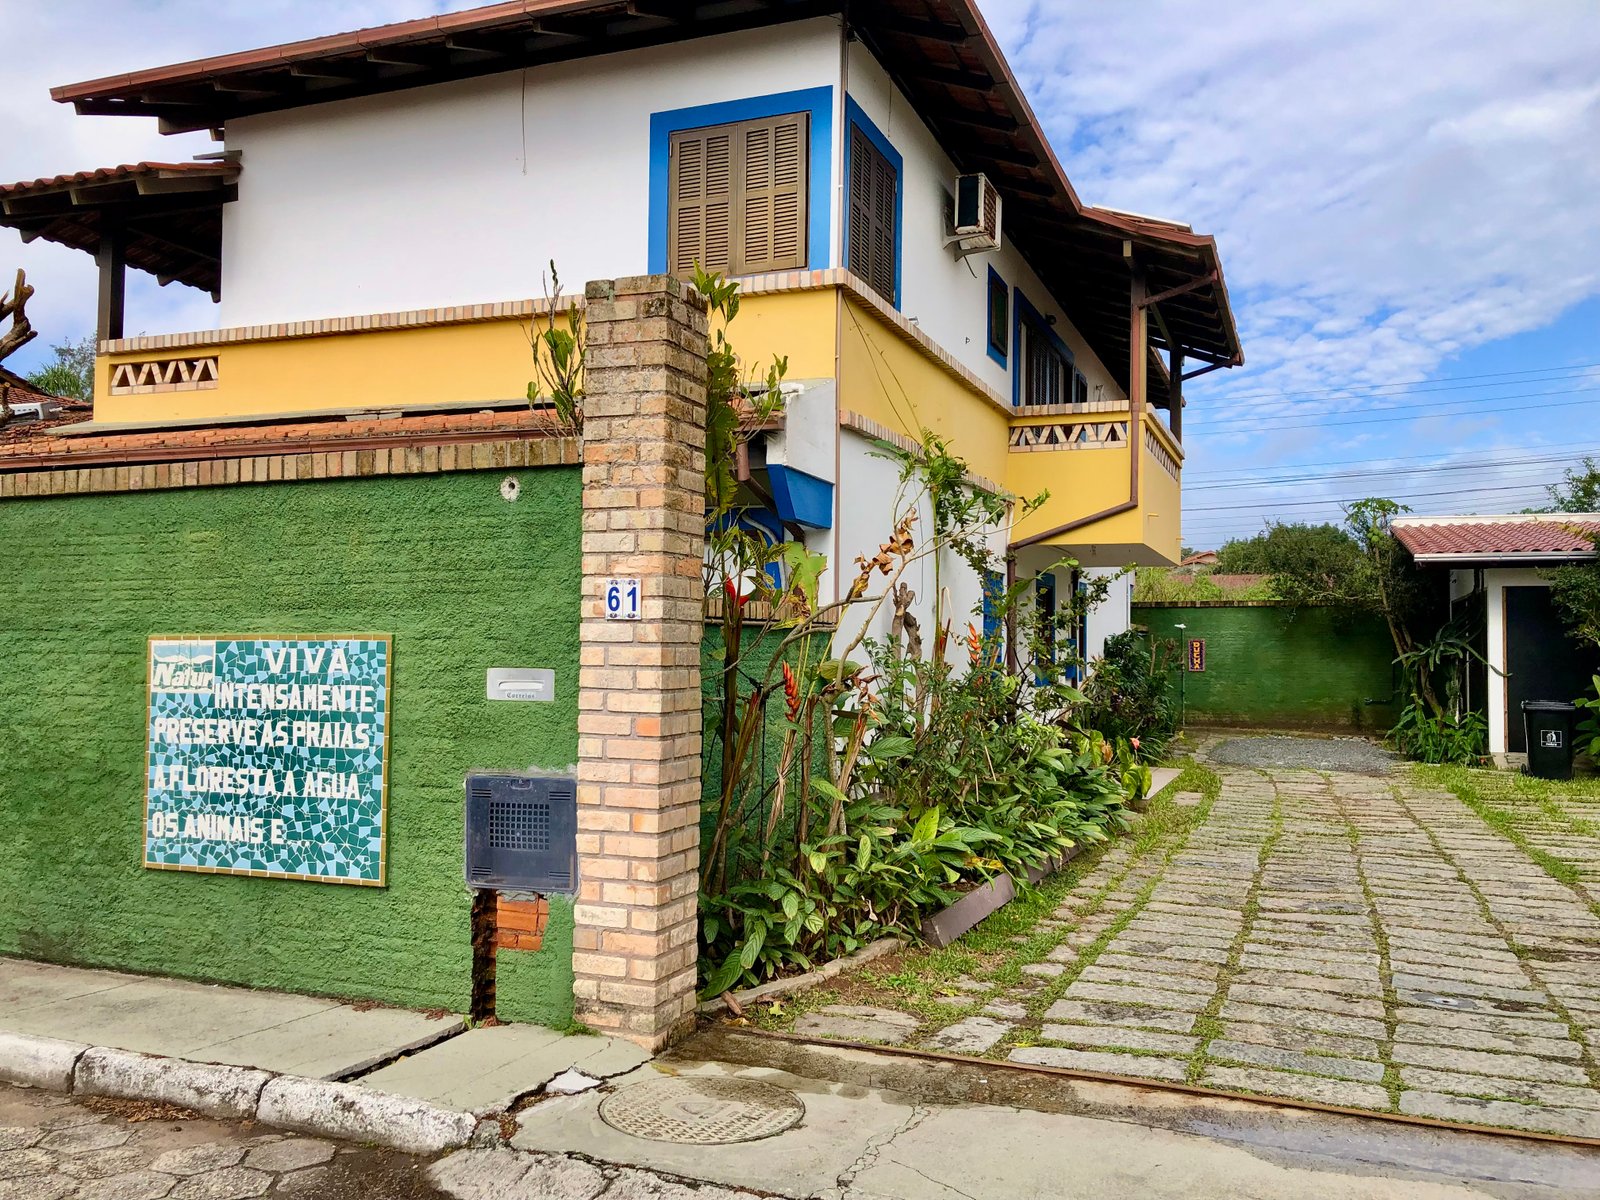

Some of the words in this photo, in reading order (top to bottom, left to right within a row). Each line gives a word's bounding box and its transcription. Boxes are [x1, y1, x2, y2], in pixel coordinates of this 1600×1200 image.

[607, 586, 637, 612] 61
[265, 647, 349, 674] VIVA
[214, 683, 374, 712] INTENSAMENTE
[154, 718, 257, 746] PRESERVE
[258, 720, 288, 747] AS
[292, 721, 370, 749] PRAIAS
[153, 767, 166, 791] A
[283, 770, 297, 797] A
[302, 771, 362, 800] AGUA
[152, 811, 178, 838] OS
[184, 813, 263, 844] ANIMAIS
